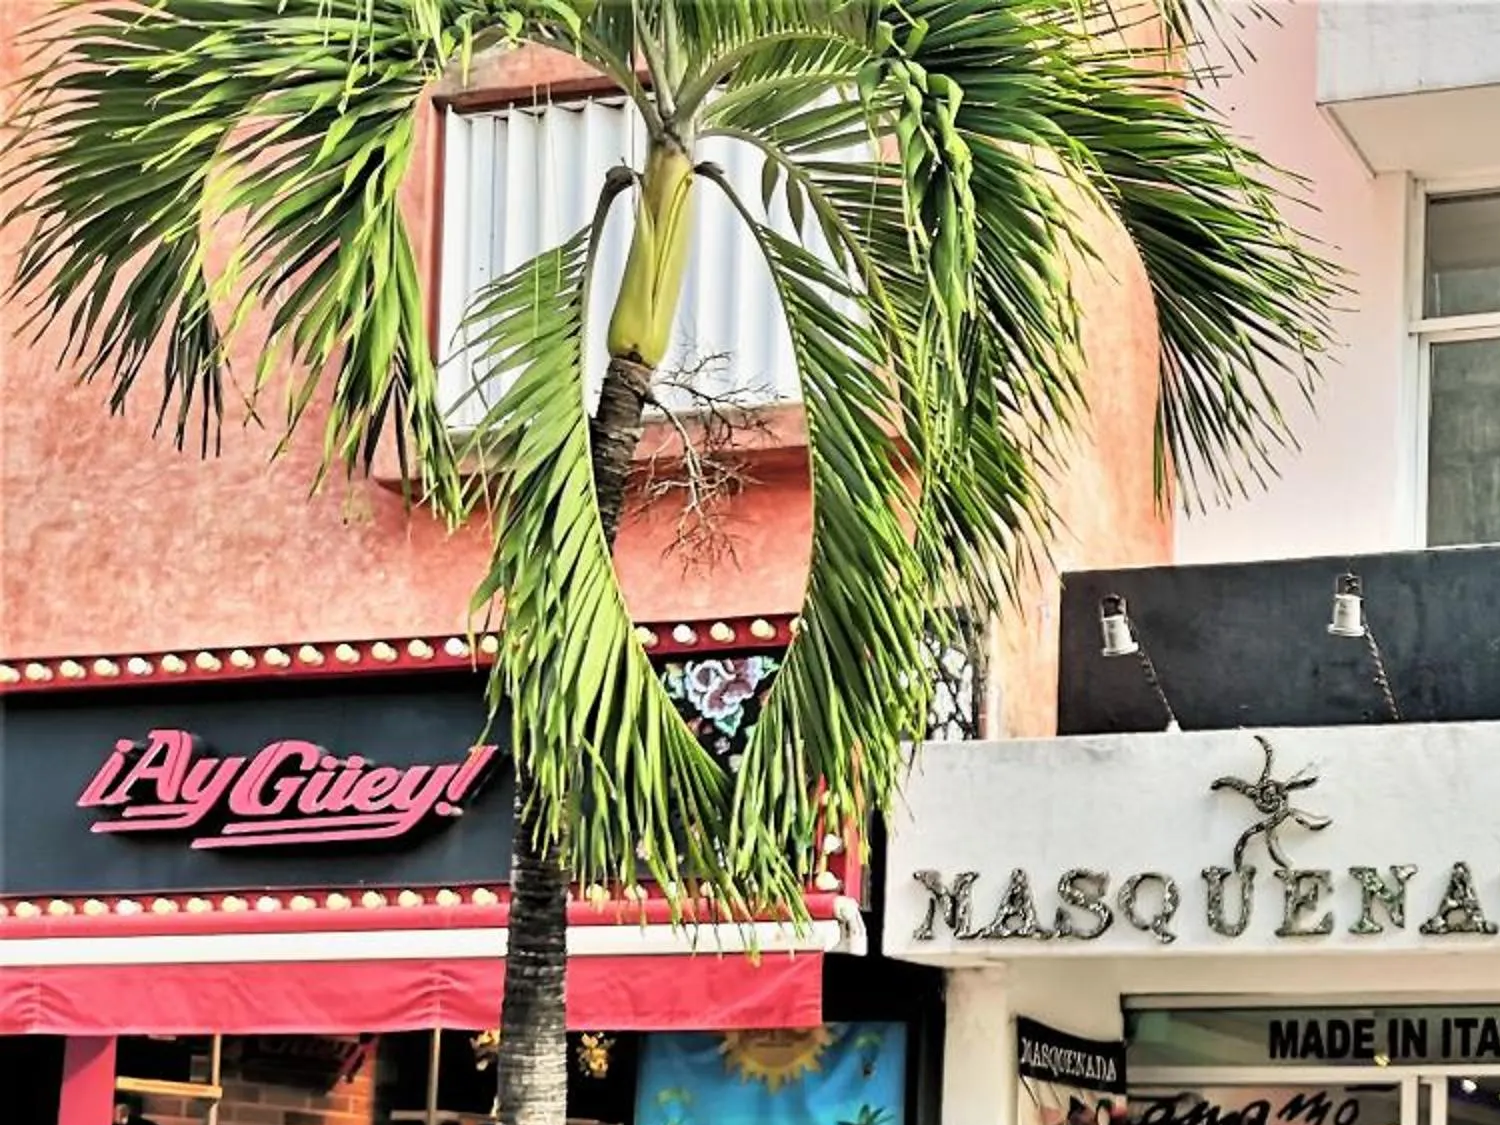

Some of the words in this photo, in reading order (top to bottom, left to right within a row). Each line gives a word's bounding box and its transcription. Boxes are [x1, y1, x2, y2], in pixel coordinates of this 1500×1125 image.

[1021, 1036, 1117, 1082] MASQUENADA
[1268, 1018, 1375, 1059] MADE
[1388, 1018, 1428, 1058] IN
